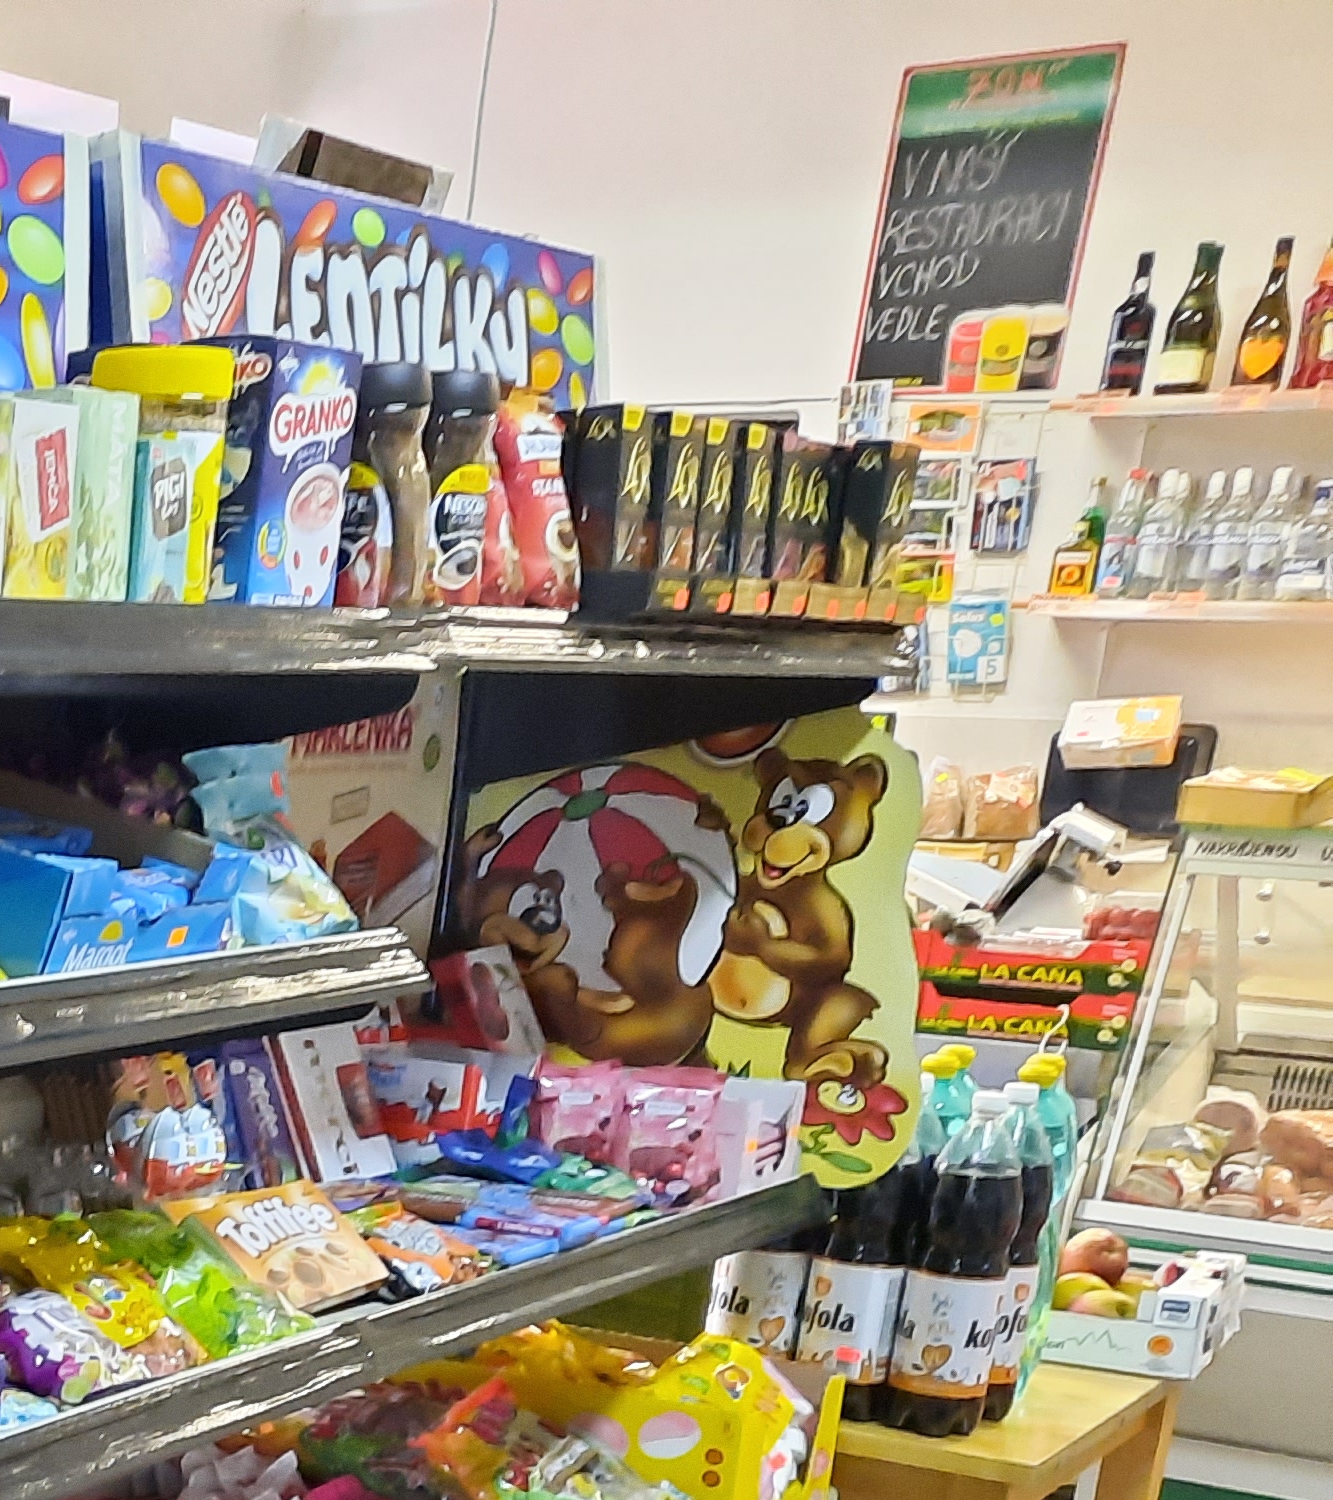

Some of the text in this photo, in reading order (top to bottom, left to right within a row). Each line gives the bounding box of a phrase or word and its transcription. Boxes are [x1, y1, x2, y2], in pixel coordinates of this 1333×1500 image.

[185, 194, 251, 334] Nestlé
[880, 254, 981, 300] VCHOD
[866, 303, 948, 345] VEDLE
[274, 395, 354, 442] GRANKO
[987, 659, 997, 675] 5
[980, 964, 1011, 982] LA
[968, 1016, 997, 1032] LA
[216, 1197, 338, 1259] Toffifee
